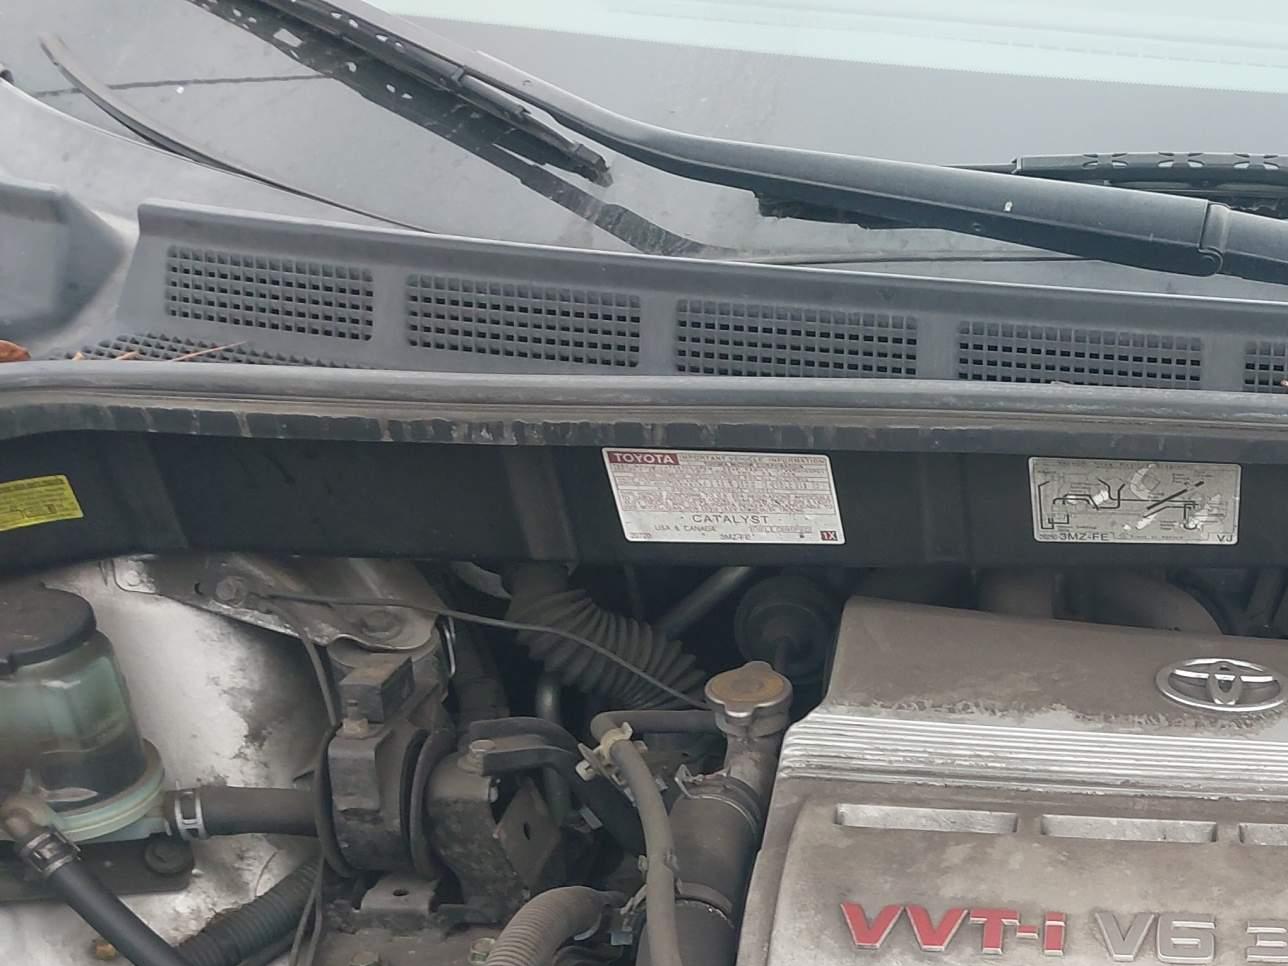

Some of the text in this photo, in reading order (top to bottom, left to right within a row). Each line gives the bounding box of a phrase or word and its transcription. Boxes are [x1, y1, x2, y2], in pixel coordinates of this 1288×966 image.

[614, 452, 674, 464] TOYOTA
[691, 514, 770, 525] CATALYST
[1059, 532, 1109, 541] 3MZ-FE
[1094, 911, 1218, 964] V6
